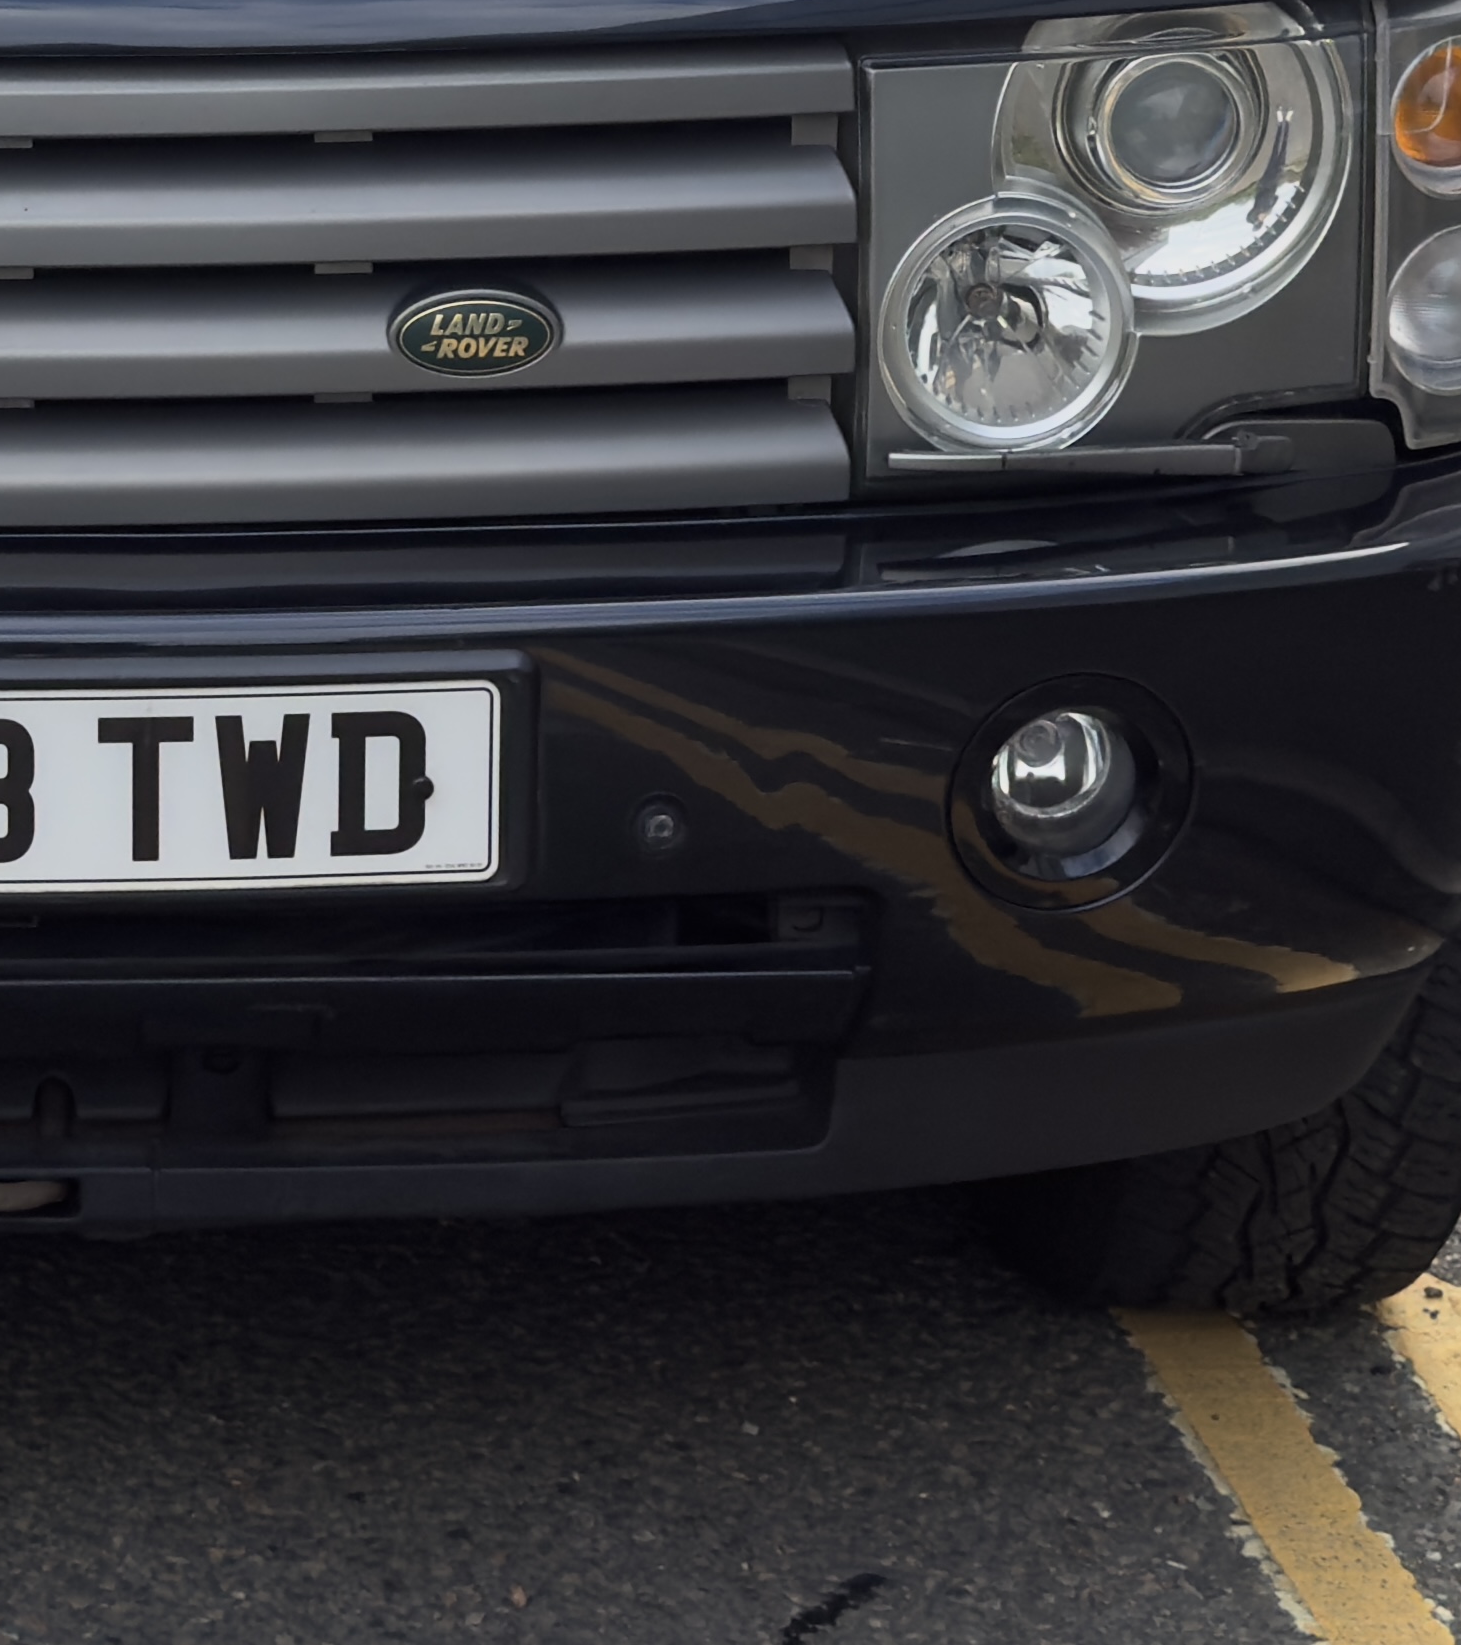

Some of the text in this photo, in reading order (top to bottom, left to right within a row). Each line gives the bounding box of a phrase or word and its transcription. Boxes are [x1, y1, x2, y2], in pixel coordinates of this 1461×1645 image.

[430, 312, 506, 336] LAND
[436, 336, 529, 359] ROVER
[97, 711, 433, 862] TWD
